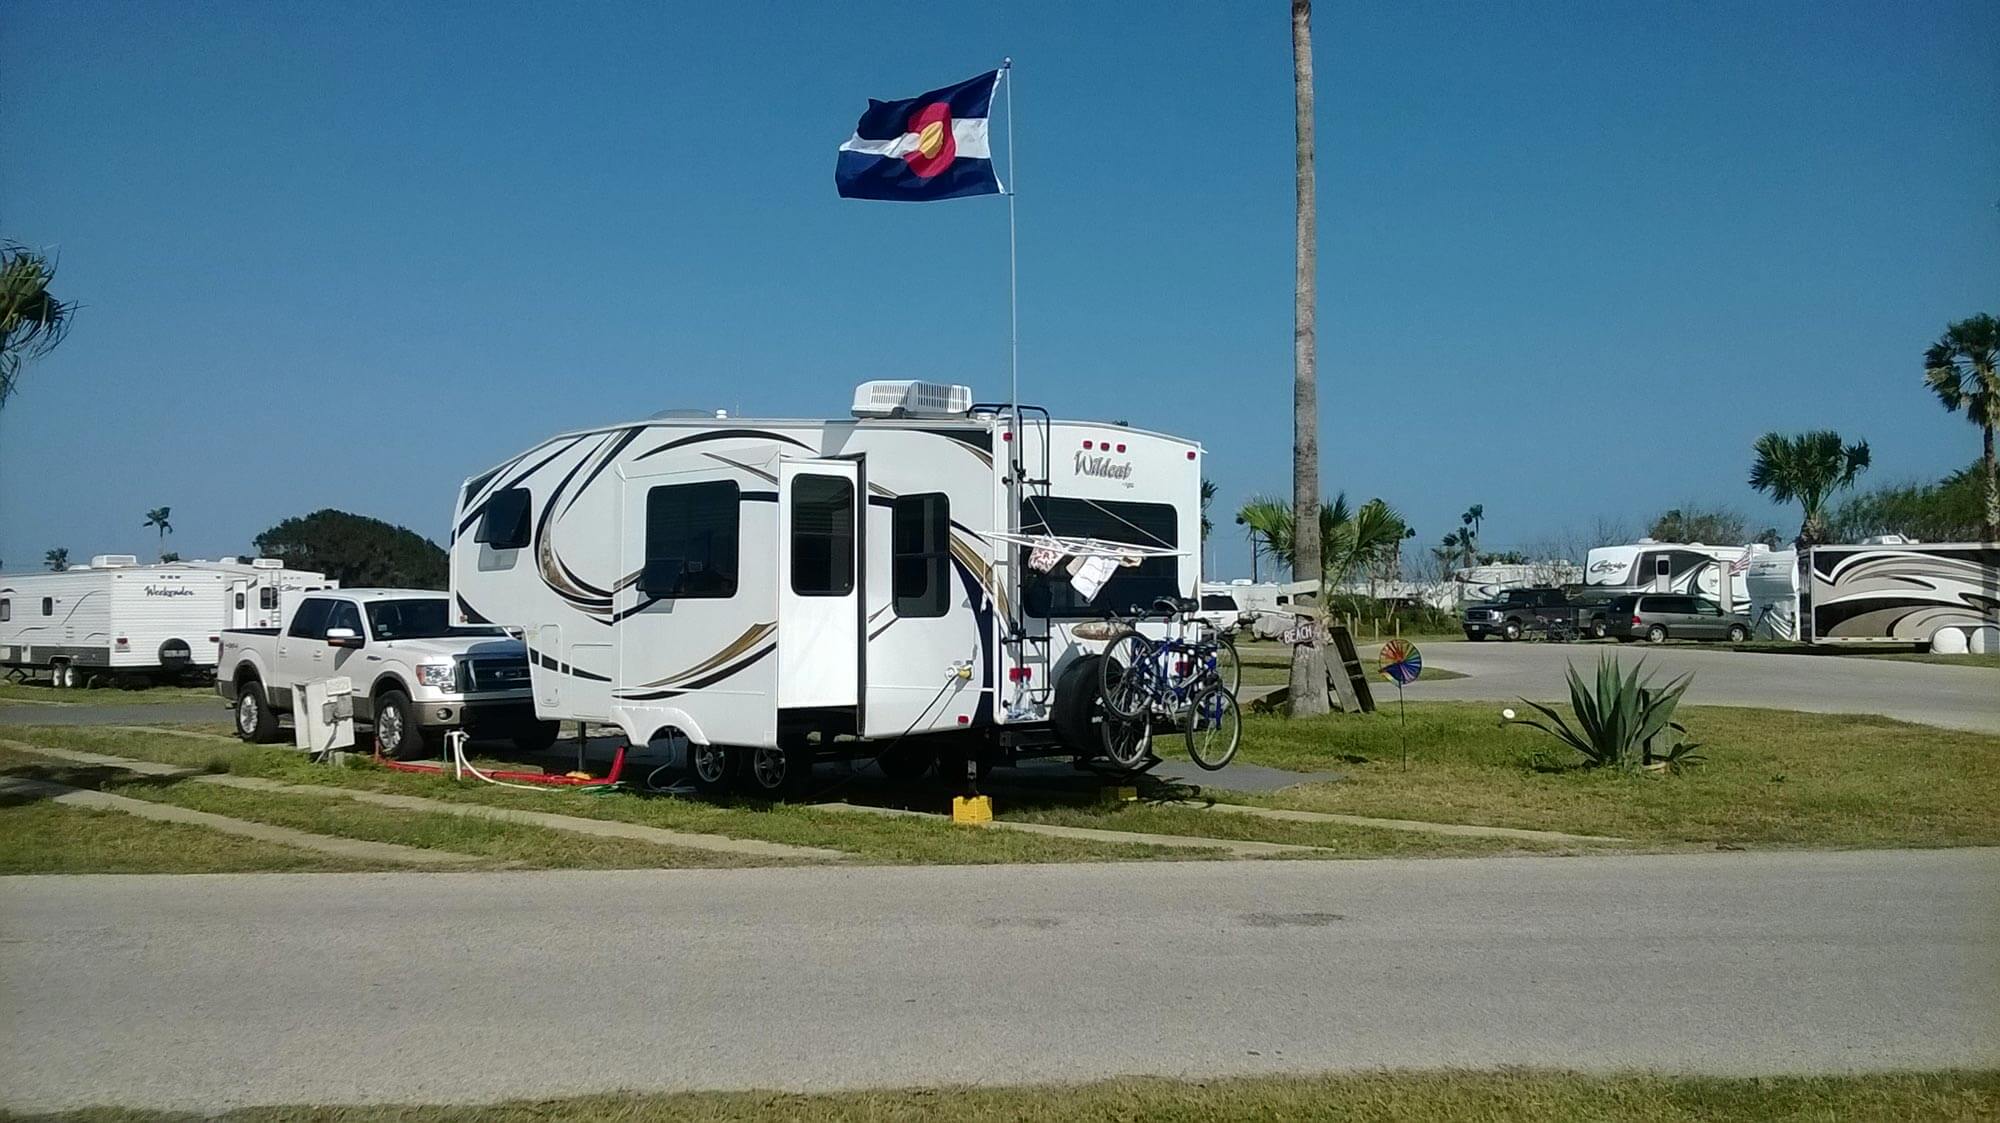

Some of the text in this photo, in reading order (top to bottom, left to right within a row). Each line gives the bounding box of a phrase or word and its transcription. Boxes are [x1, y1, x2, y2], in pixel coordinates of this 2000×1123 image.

[1074, 450, 1133, 480] Wildcat
[144, 584, 195, 598] Weekender
[1284, 625, 1312, 643] BEACH
